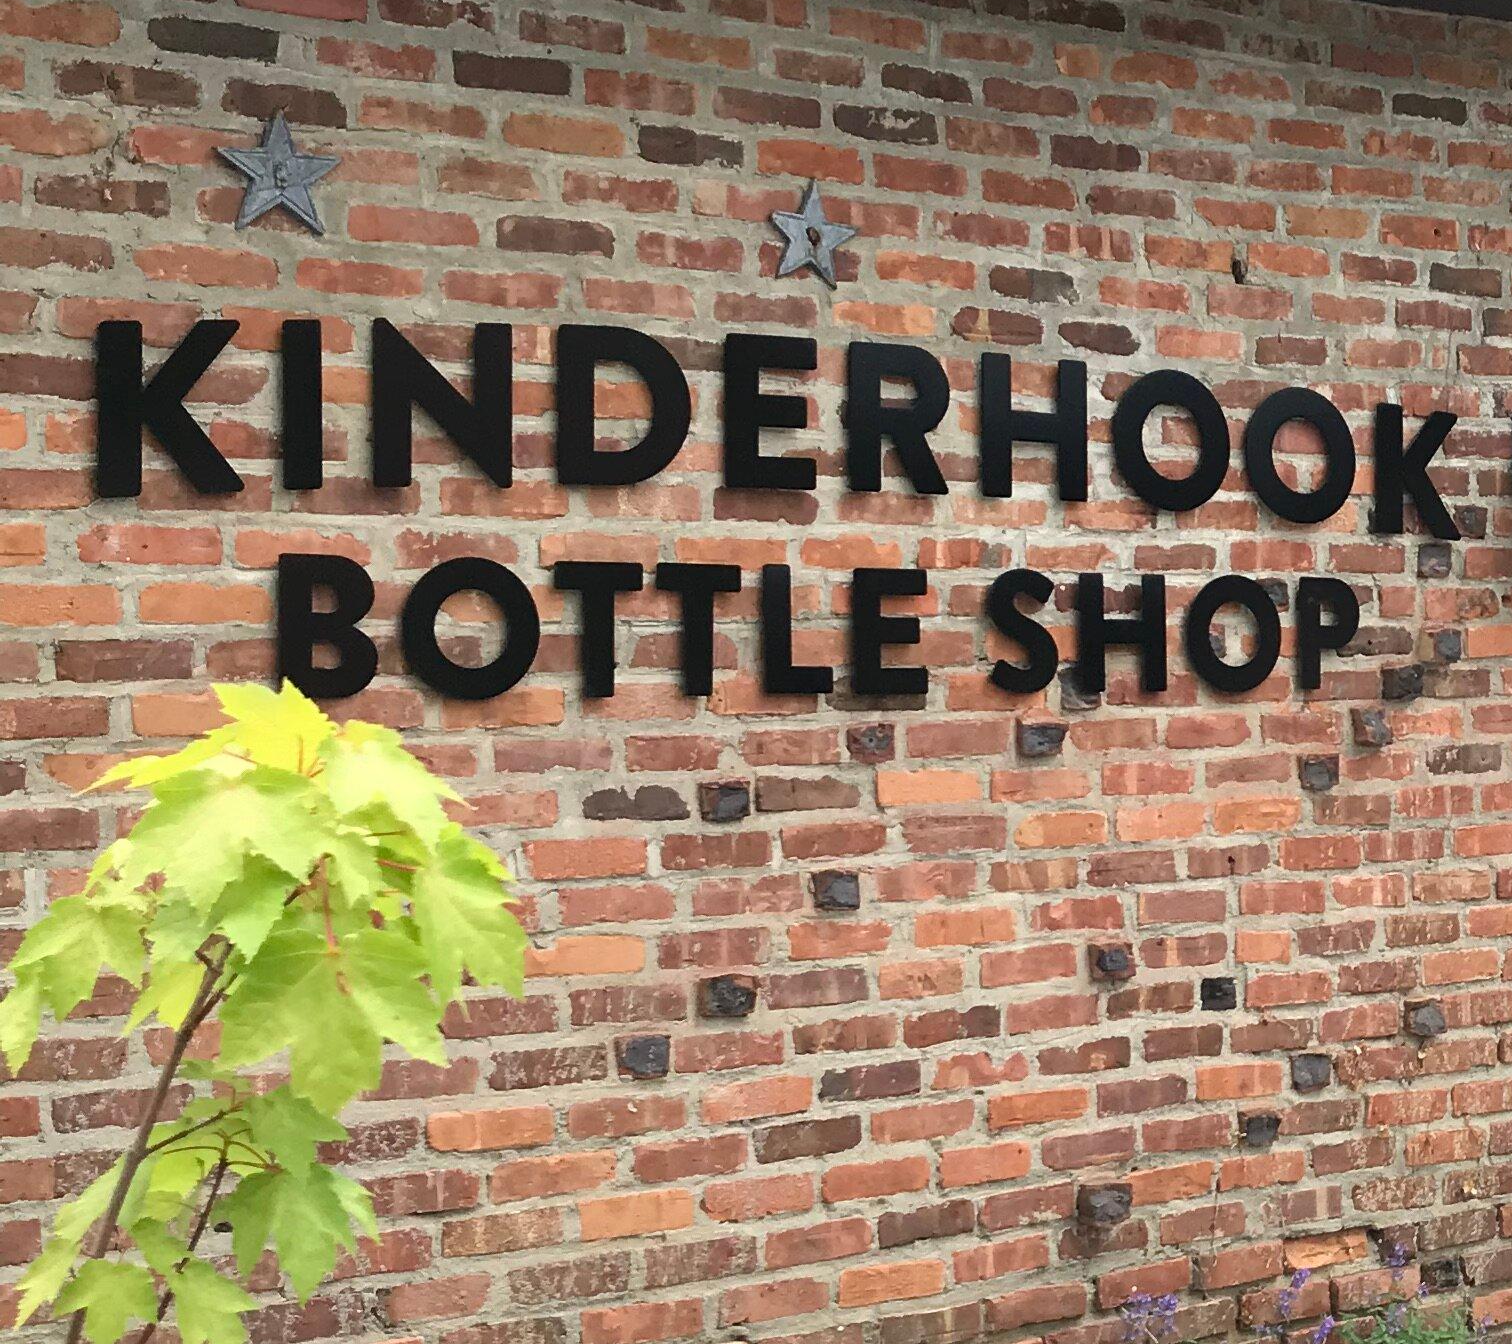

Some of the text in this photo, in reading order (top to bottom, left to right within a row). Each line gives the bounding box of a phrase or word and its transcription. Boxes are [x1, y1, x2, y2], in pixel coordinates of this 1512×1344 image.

[88, 319, 1461, 540] KINDERHOOK
[276, 553, 1360, 701] BOTTLE SHOP
